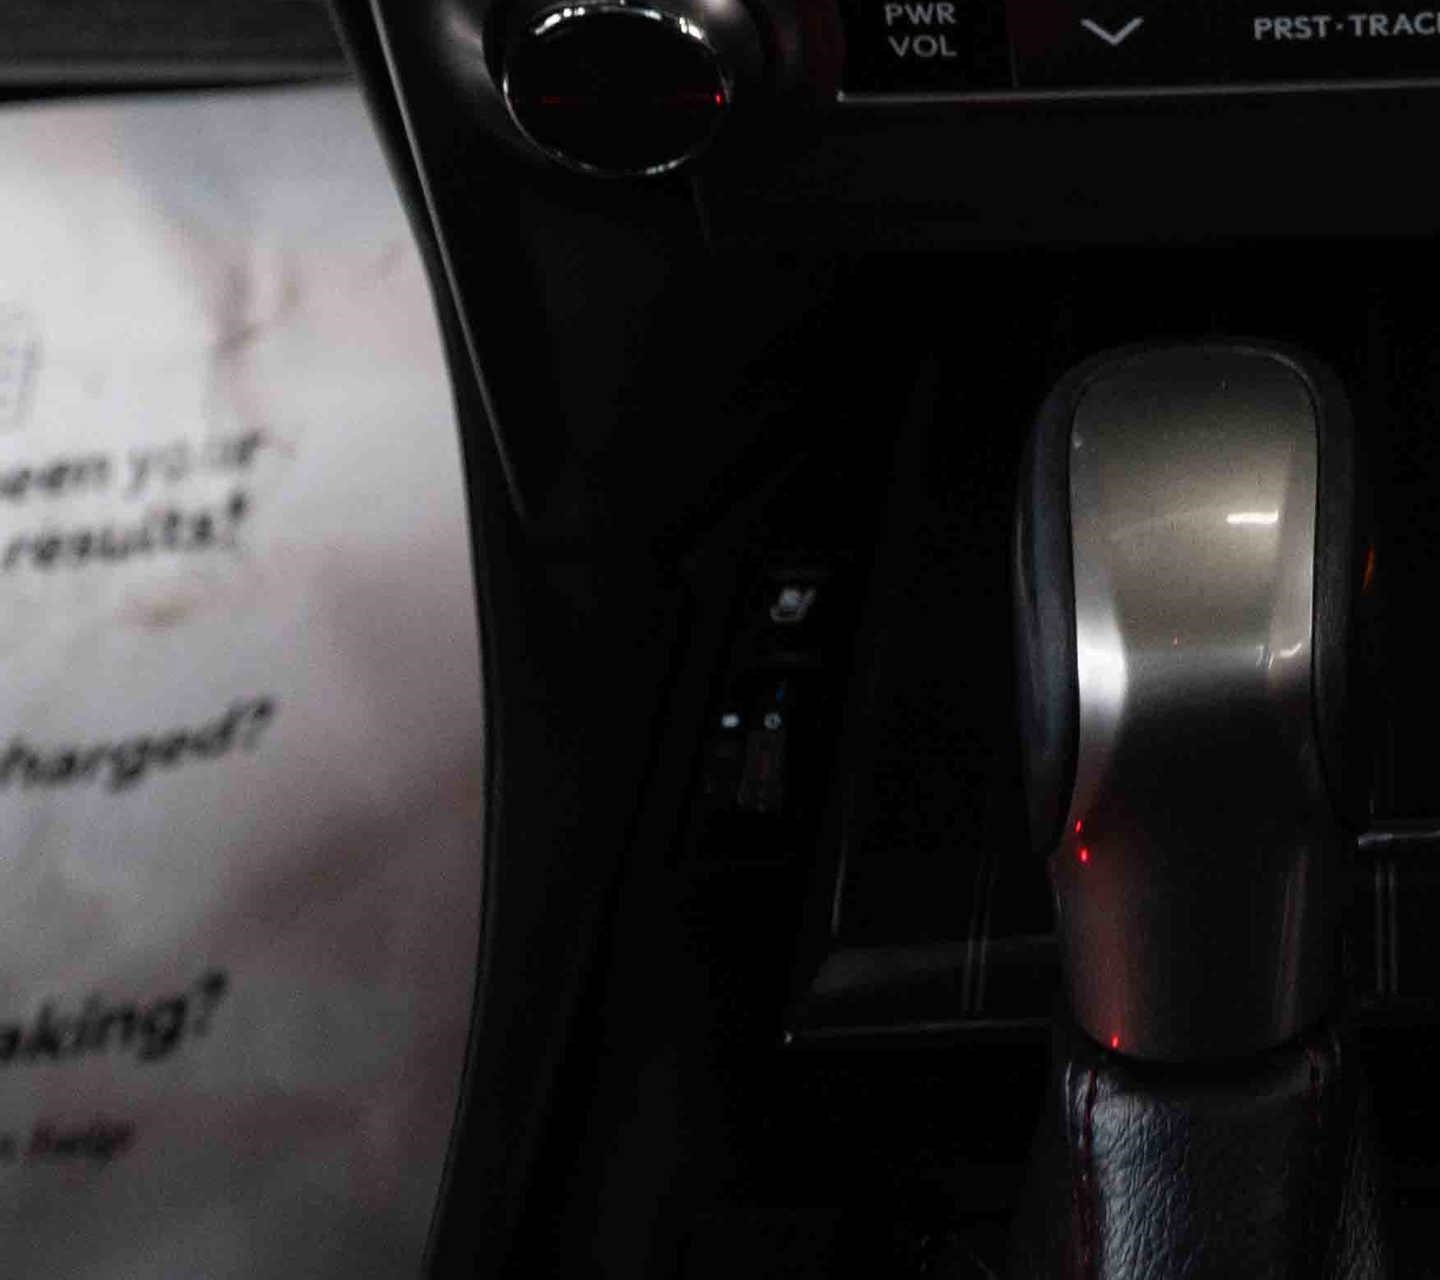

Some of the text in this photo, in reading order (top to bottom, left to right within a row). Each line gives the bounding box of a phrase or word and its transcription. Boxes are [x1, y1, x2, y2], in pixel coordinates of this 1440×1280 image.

[885, 1, 958, 29] PWR
[887, 30, 958, 60] VOL
[0, 487, 252, 572] results?
